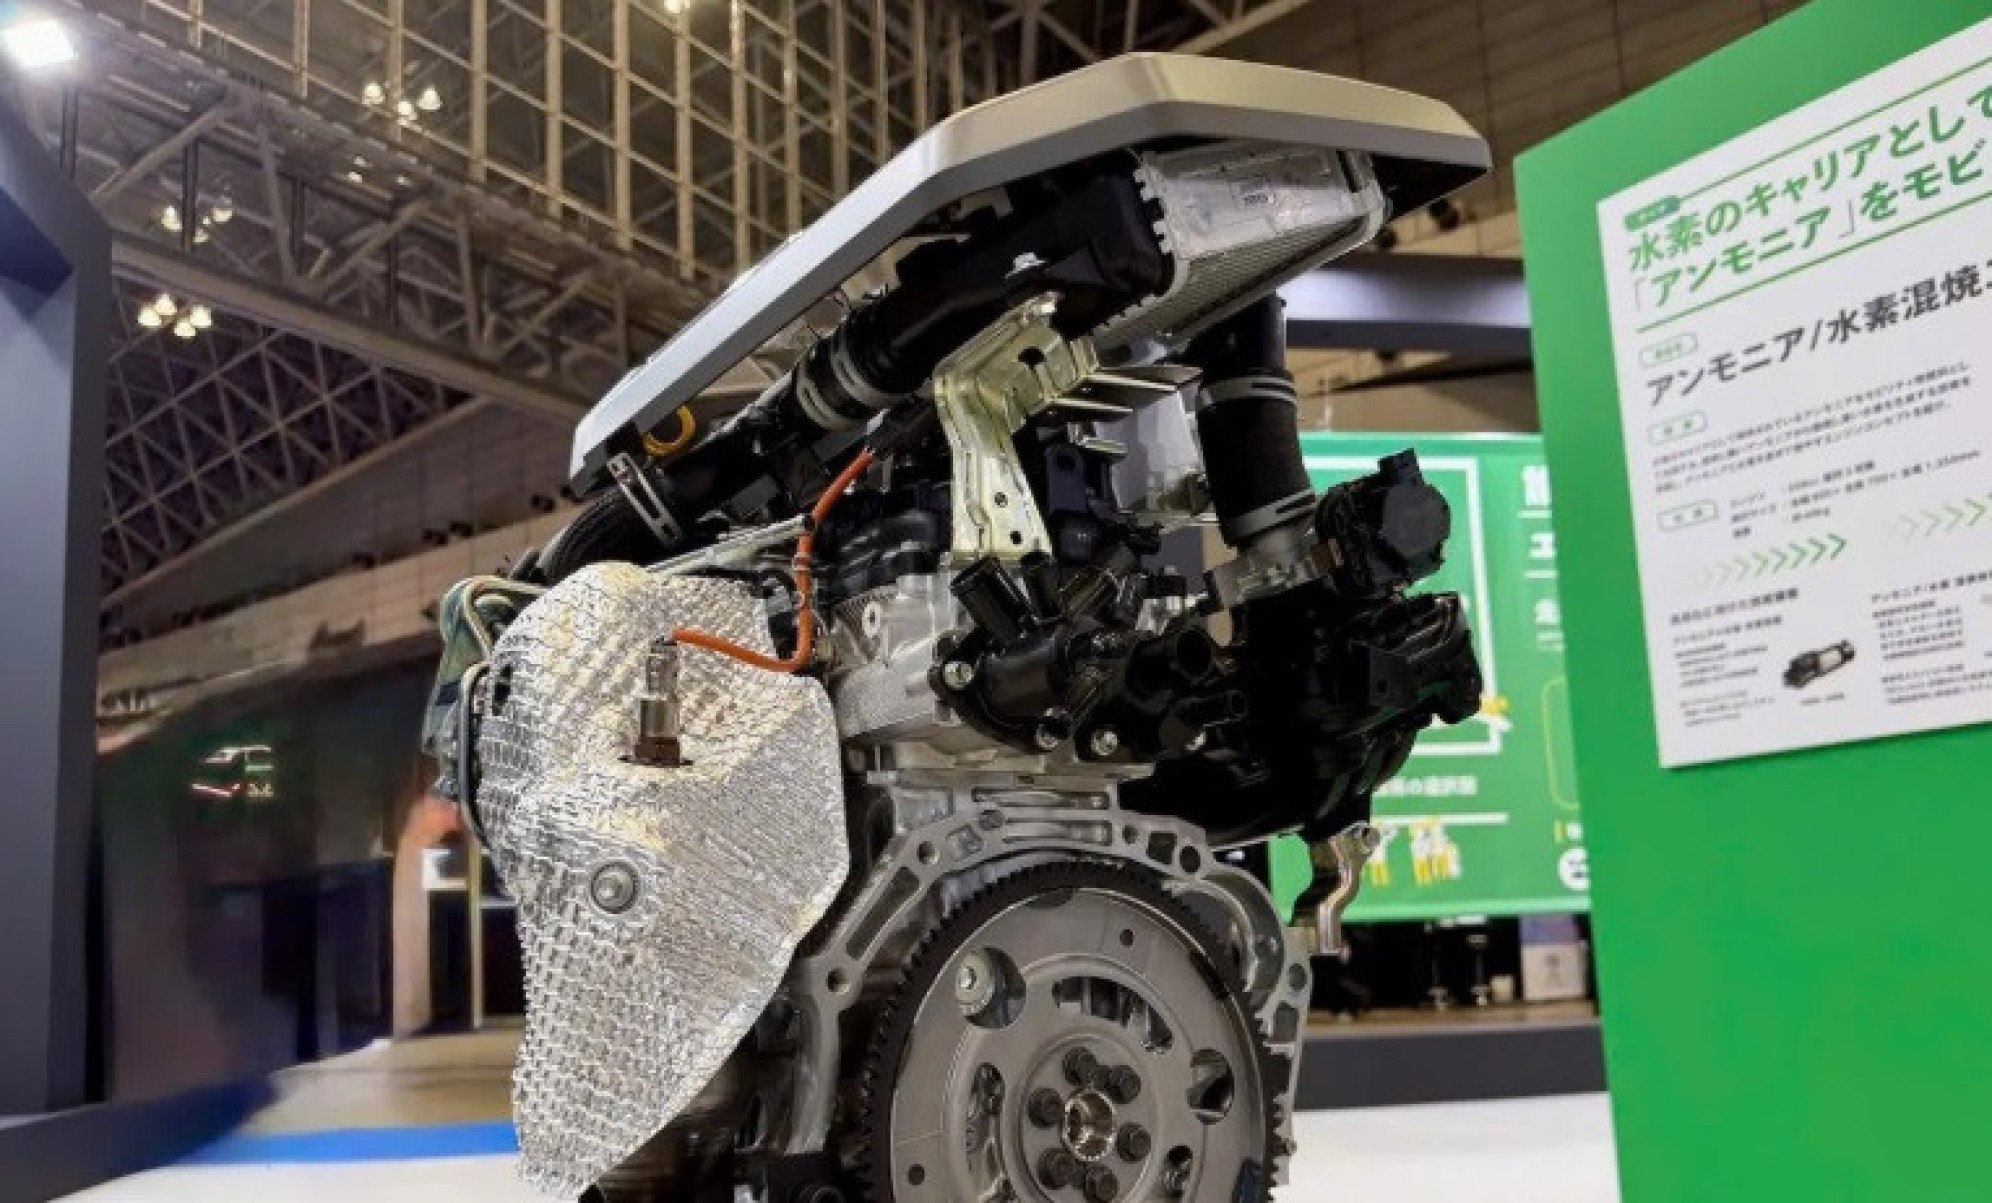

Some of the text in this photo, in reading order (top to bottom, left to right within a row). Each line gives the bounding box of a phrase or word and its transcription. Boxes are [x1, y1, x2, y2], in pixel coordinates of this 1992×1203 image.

[1647, 258, 1992, 406] アンモニア/水素混焼
